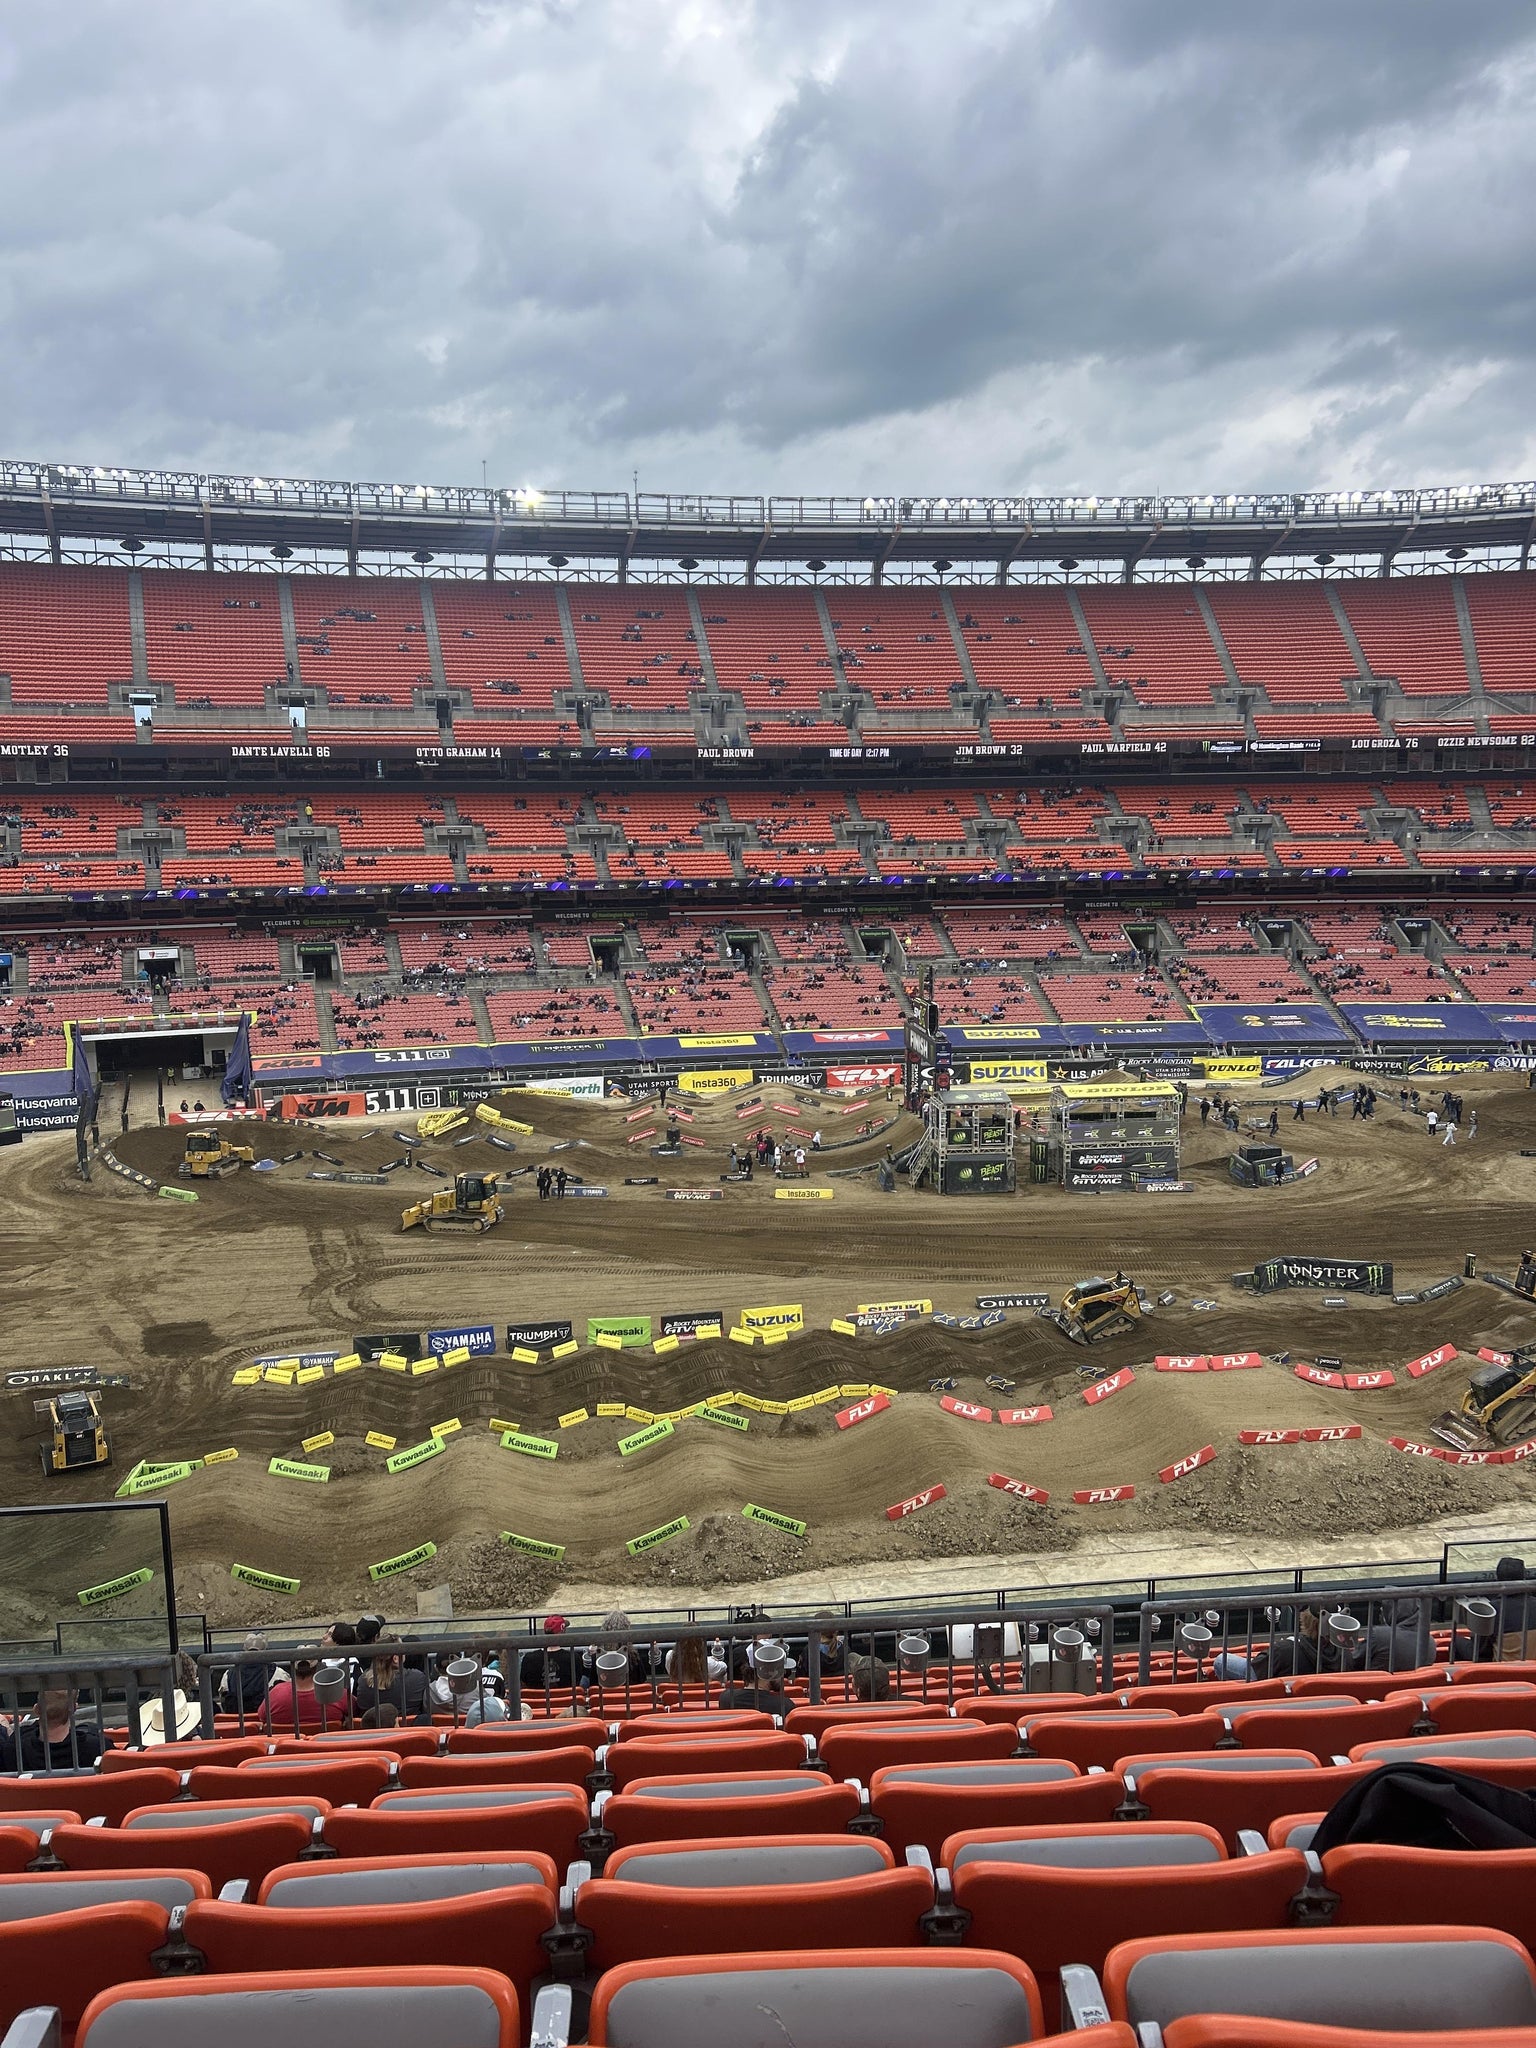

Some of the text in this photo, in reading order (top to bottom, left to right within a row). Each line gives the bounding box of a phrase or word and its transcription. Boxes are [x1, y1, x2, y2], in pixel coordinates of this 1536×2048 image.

[1081, 742, 1167, 753] PAUL WARFIELD 42
[1351, 738, 1419, 749] LOU GROZA 76
[1438, 735, 1535, 747] OZZIE NEWSOME 82
[1, 744, 69, 756] MOTLEY 36
[232, 746, 330, 757] DANTE LAVELLI 86
[416, 747, 502, 758] OTTO GRAHAM 14
[697, 748, 754, 758] PAUL BROWN
[829, 748, 844, 758] TIME
[844, 748, 851, 758] OF
[851, 748, 862, 758] DAY
[880, 748, 890, 758] PM
[955, 744, 1023, 755] JIM BROWN 32
[374, 1051, 424, 1062] 5.11
[1153, 1057, 1193, 1065] MOUNTAIN
[260, 1058, 315, 1069] KTM
[1355, 1060, 1403, 1070] MONSTER
[1430, 1060, 1489, 1073] alpinestars
[1511, 1058, 1536, 1069] YAM
[759, 1074, 810, 1084] TRIUMPH
[834, 1067, 898, 1081] FLY
[973, 1066, 1045, 1079] SUZUKI
[1071, 1071, 1089, 1079] U.S.
[692, 1077, 736, 1088] Insta360
[462, 1091, 489, 1101] MONS
[1085, 1085, 1169, 1094] DUNLOP
[15, 1096, 78, 1110] Husqvarna
[297, 1097, 349, 1117] KTM
[366, 1089, 414, 1114] 5.11
[16, 1114, 80, 1128] Husqvarna
[983, 1128, 1004, 1139] BEAST
[980, 1164, 1005, 1177] BEAST
[787, 1190, 821, 1198] Insta360
[998, 1297, 1048, 1308] OAKLEY
[692, 1318, 720, 1326] MOUNTAIN
[746, 1313, 801, 1327] SUZUKI
[510, 1330, 558, 1341] TRIUMPH
[596, 1327, 644, 1336] Kawasaki
[444, 1331, 492, 1348] YAMAHA
[309, 1357, 334, 1365] YAMAHA
[1169, 1358, 1194, 1368] FLY
[1223, 1355, 1248, 1367] FLY
[1420, 1350, 1444, 1371] FLY
[1309, 1369, 1333, 1382] FLY
[1357, 1374, 1382, 1386] FLY
[1095, 1376, 1120, 1396] FLY
[849, 1400, 875, 1421] FLY
[953, 1401, 981, 1415] FLY
[1012, 1408, 1040, 1421] FLY
[702, 1407, 745, 1427] Kawasaki
[624, 1423, 669, 1450] Kawasaki
[1255, 1431, 1288, 1443] FLY
[1319, 1427, 1351, 1441] FLY
[508, 1436, 553, 1454] Kawasaki
[1403, 1443, 1434, 1455] FLY
[1515, 1441, 1536, 1460] FLY
[393, 1441, 438, 1468] Kawasaki
[1458, 1454, 1489, 1464] FLY
[276, 1463, 325, 1479] Kawasaki
[1173, 1452, 1202, 1478] FLY
[136, 1468, 183, 1488] Kawasaki
[1004, 1480, 1038, 1497] FLY
[1090, 1488, 1122, 1502] FLY
[902, 1491, 933, 1515] FLY
[751, 1508, 800, 1533] Kawasaki
[634, 1520, 684, 1551] Kawasaki
[508, 1535, 558, 1557] Kawasaki
[376, 1548, 429, 1576] Kawasaki
[237, 1569, 293, 1591] Kawasaki
[86, 1575, 142, 1601] Kawasaki
